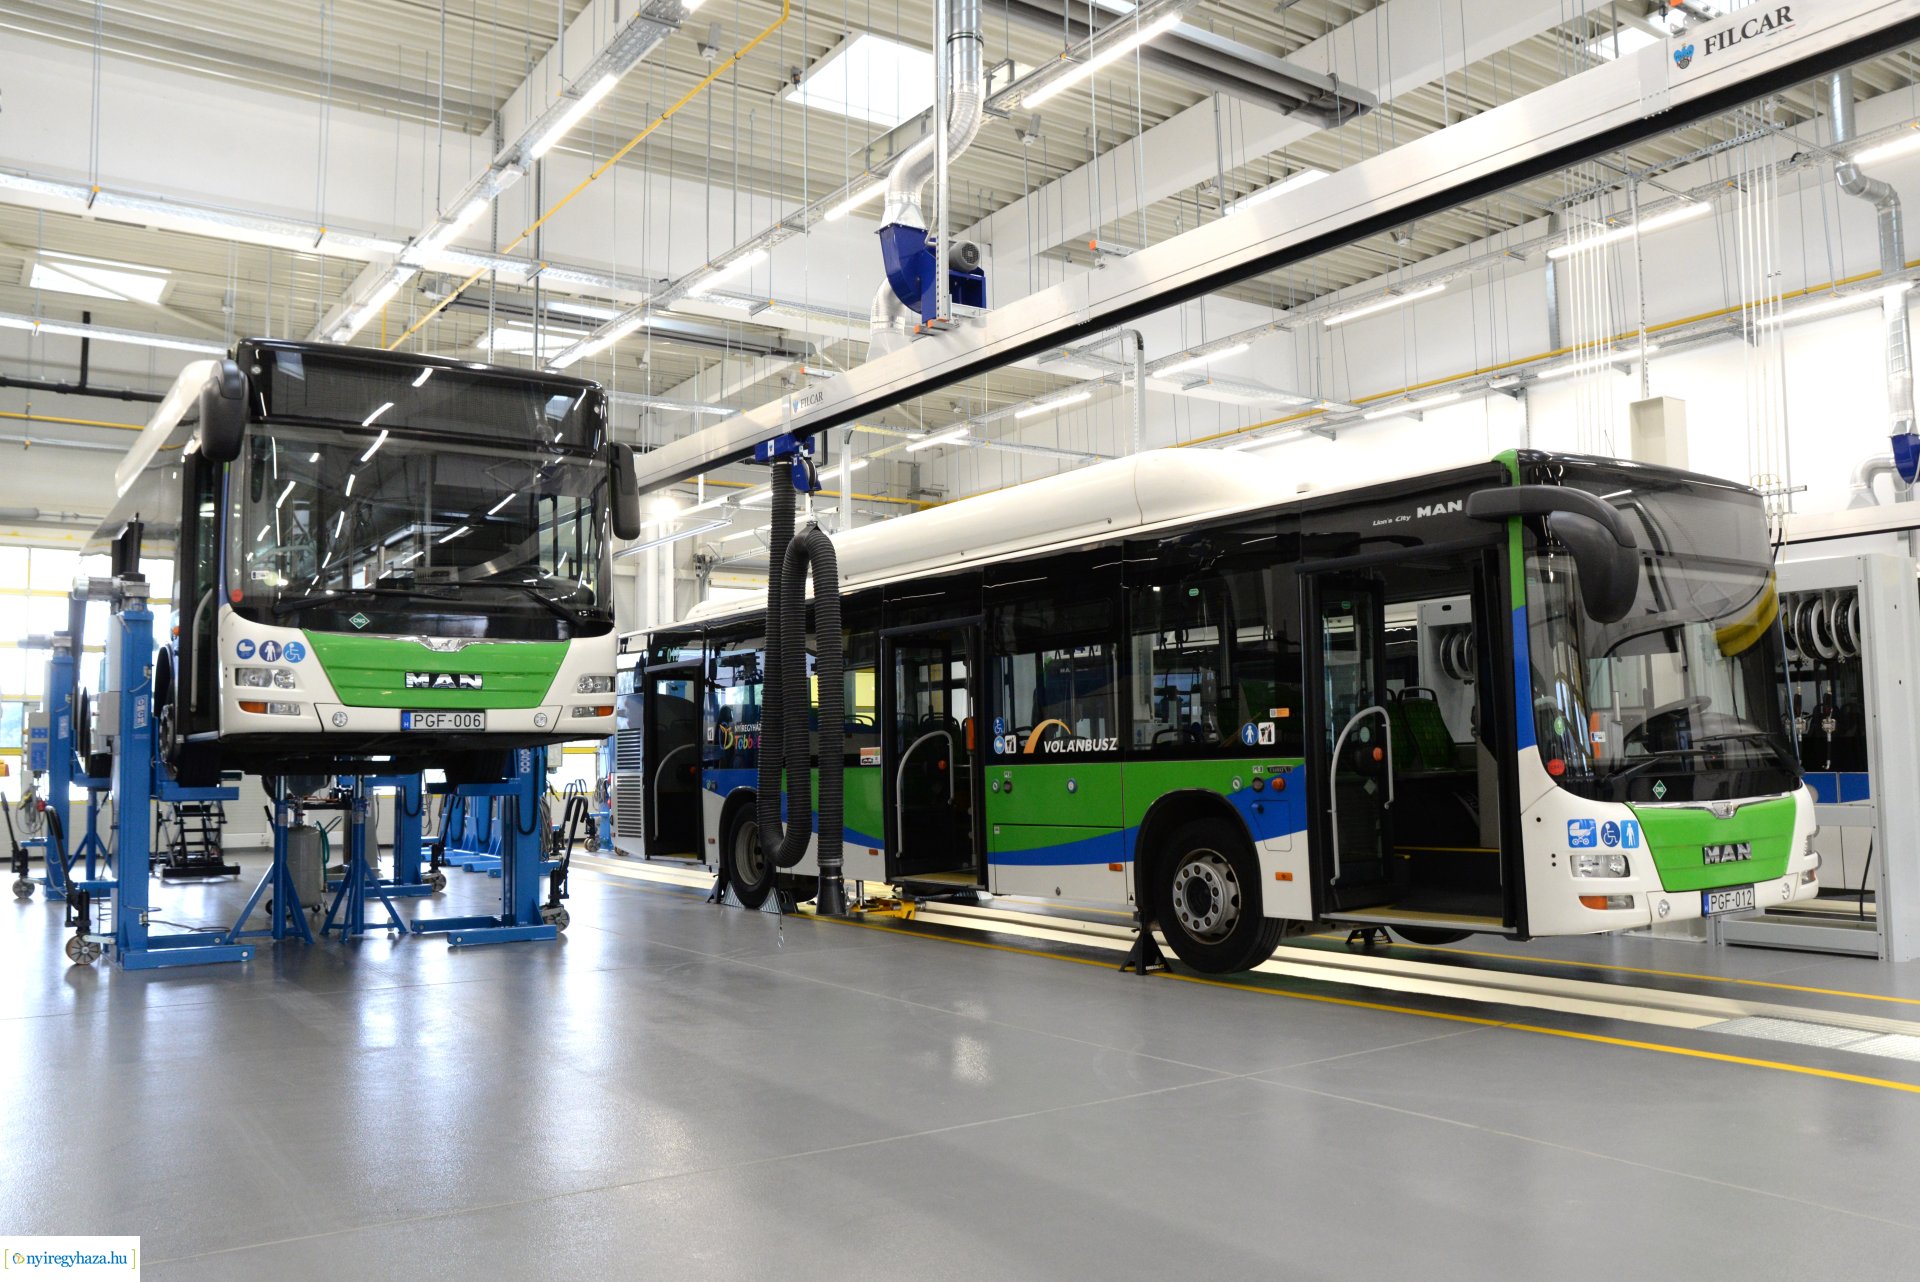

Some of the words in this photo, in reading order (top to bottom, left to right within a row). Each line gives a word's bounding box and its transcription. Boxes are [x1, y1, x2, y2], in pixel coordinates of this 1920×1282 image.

[1704, 6, 1794, 56] FILCAR
[800, 391, 824, 408] FILCAR
[1416, 500, 1462, 518] MAN
[1372, 518, 1393, 526] Lion's
[1395, 514, 1411, 523] City
[405, 671, 483, 690] MAN
[413, 714, 481, 728] PGF-006
[1704, 842, 1752, 865] MAN
[1710, 889, 1752, 911] PGF-012
